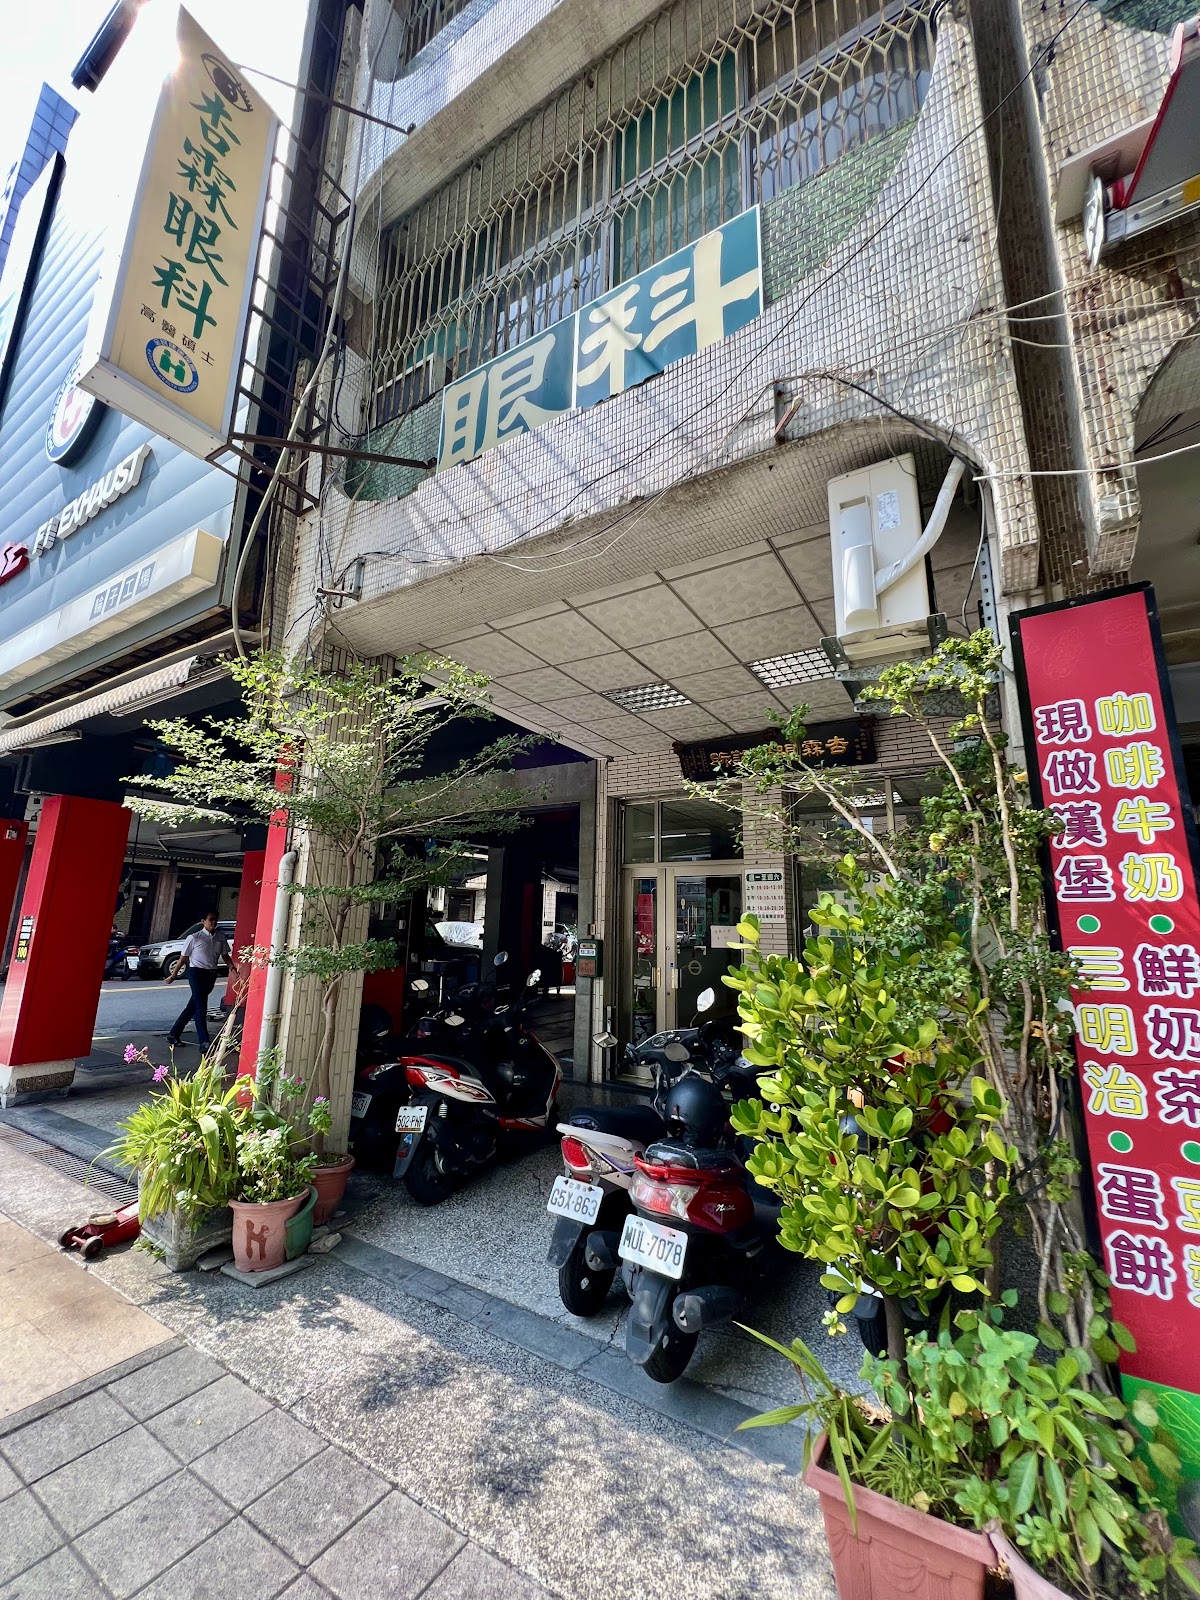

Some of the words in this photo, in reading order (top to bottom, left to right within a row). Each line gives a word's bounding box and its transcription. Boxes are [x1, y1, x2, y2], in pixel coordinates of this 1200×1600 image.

[151, 88, 242, 340] 杏霖眼科
[436, 230, 760, 472] 眼科
[57, 443, 151, 538] EXHAUST
[1037, 702, 1113, 899] 現做漢堡
[1098, 694, 1180, 899] 咖啡牛奶
[1070, 949, 1144, 1116] 三明治
[550, 1187, 599, 1219] G5X-863
[621, 1226, 683, 1267] MUL-7078
[1102, 1166, 1171, 1296] 蛋餅
